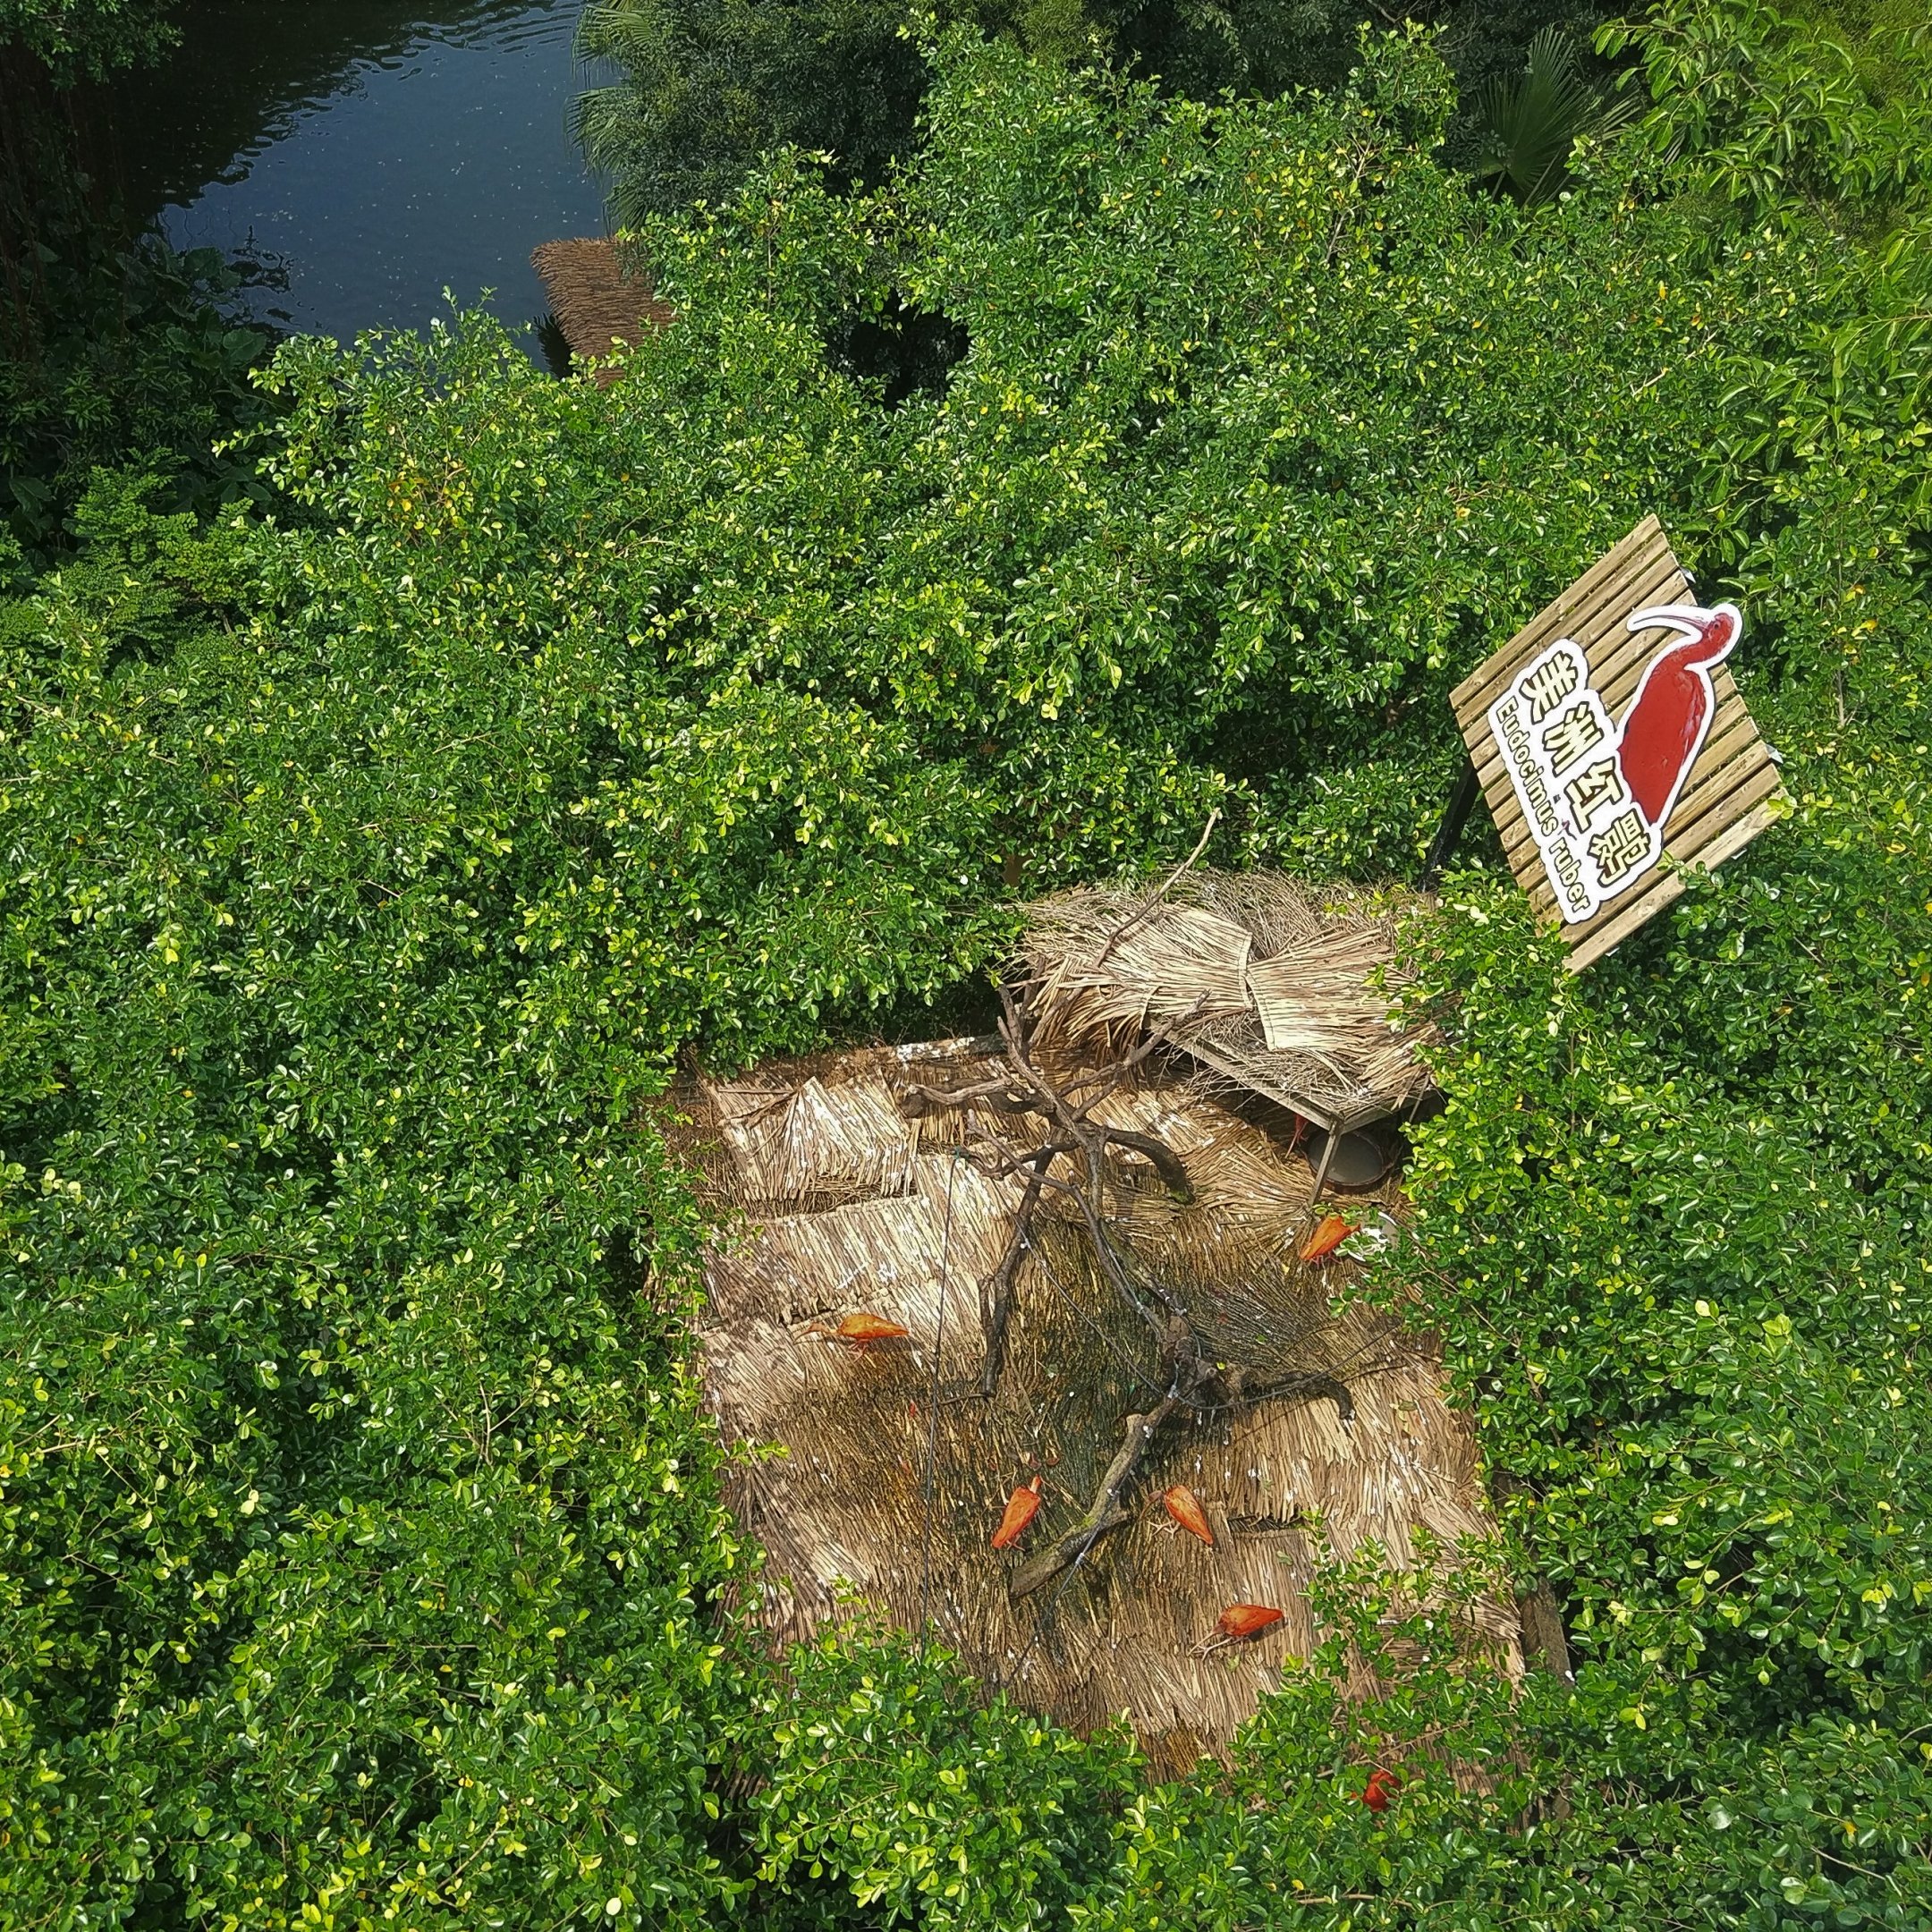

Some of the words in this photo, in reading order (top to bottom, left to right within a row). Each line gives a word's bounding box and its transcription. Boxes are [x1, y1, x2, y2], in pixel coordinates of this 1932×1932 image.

[1496, 695, 1558, 836] Eudocimus
[1548, 836, 1591, 913] ruber
[1521, 650, 1650, 888] 美洲红鹮
